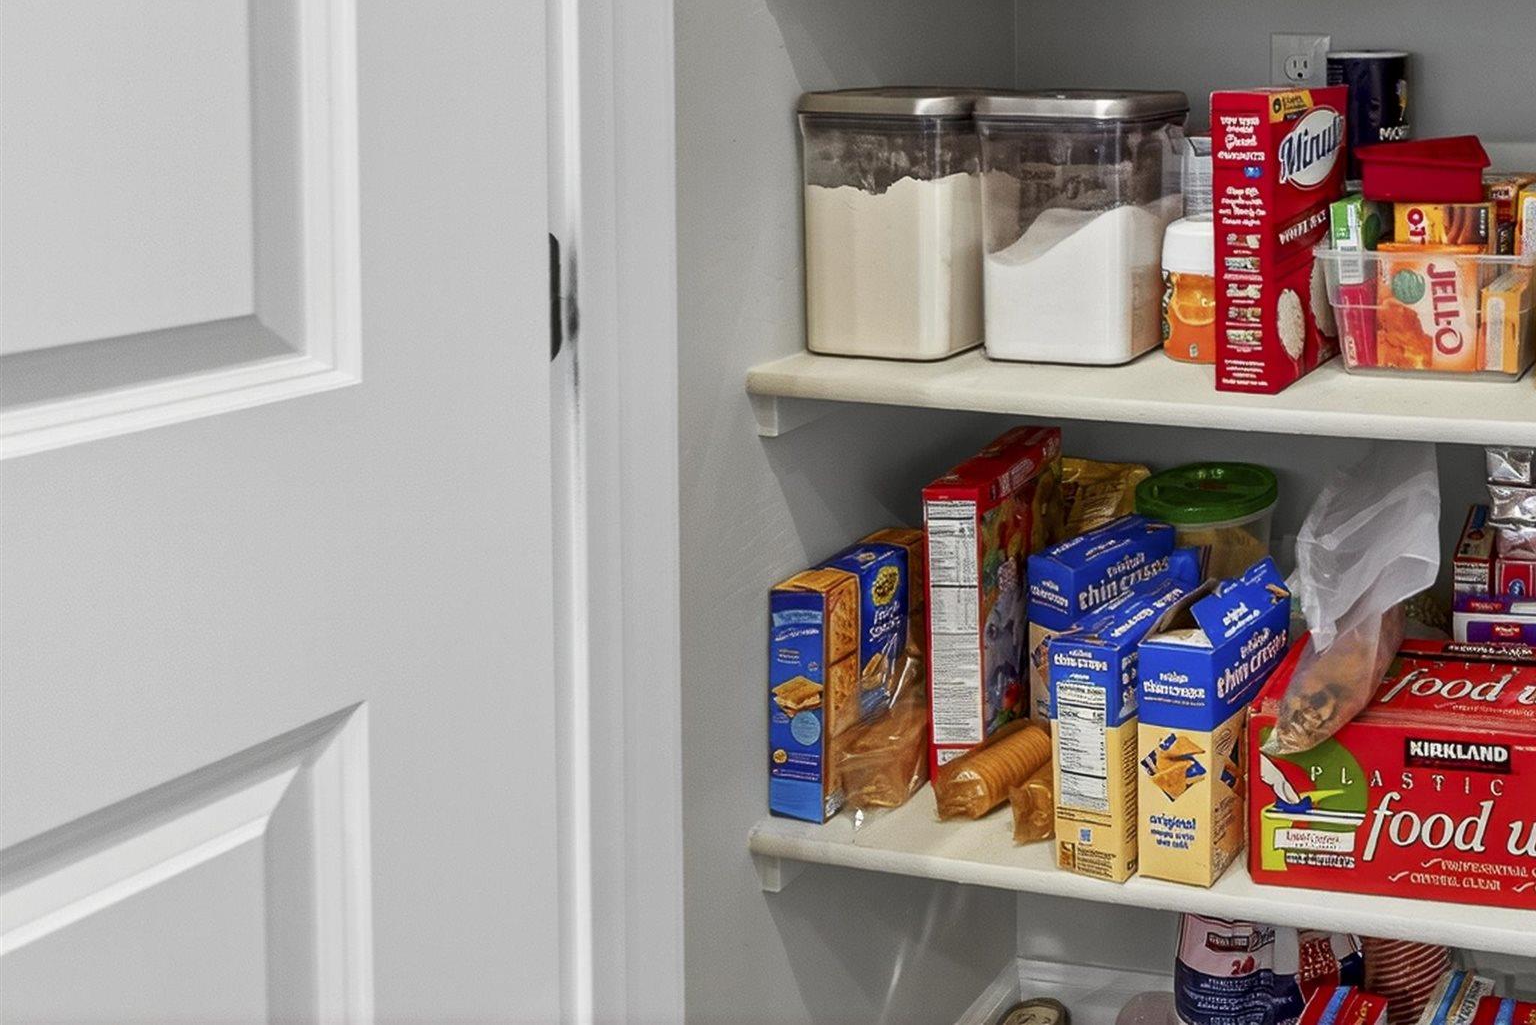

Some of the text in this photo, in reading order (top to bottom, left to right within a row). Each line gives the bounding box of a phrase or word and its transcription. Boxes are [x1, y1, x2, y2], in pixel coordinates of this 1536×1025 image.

[1380, 667, 1513, 703] food
[1409, 739, 1509, 763] KIRKLAND
[1362, 791, 1496, 862] food
